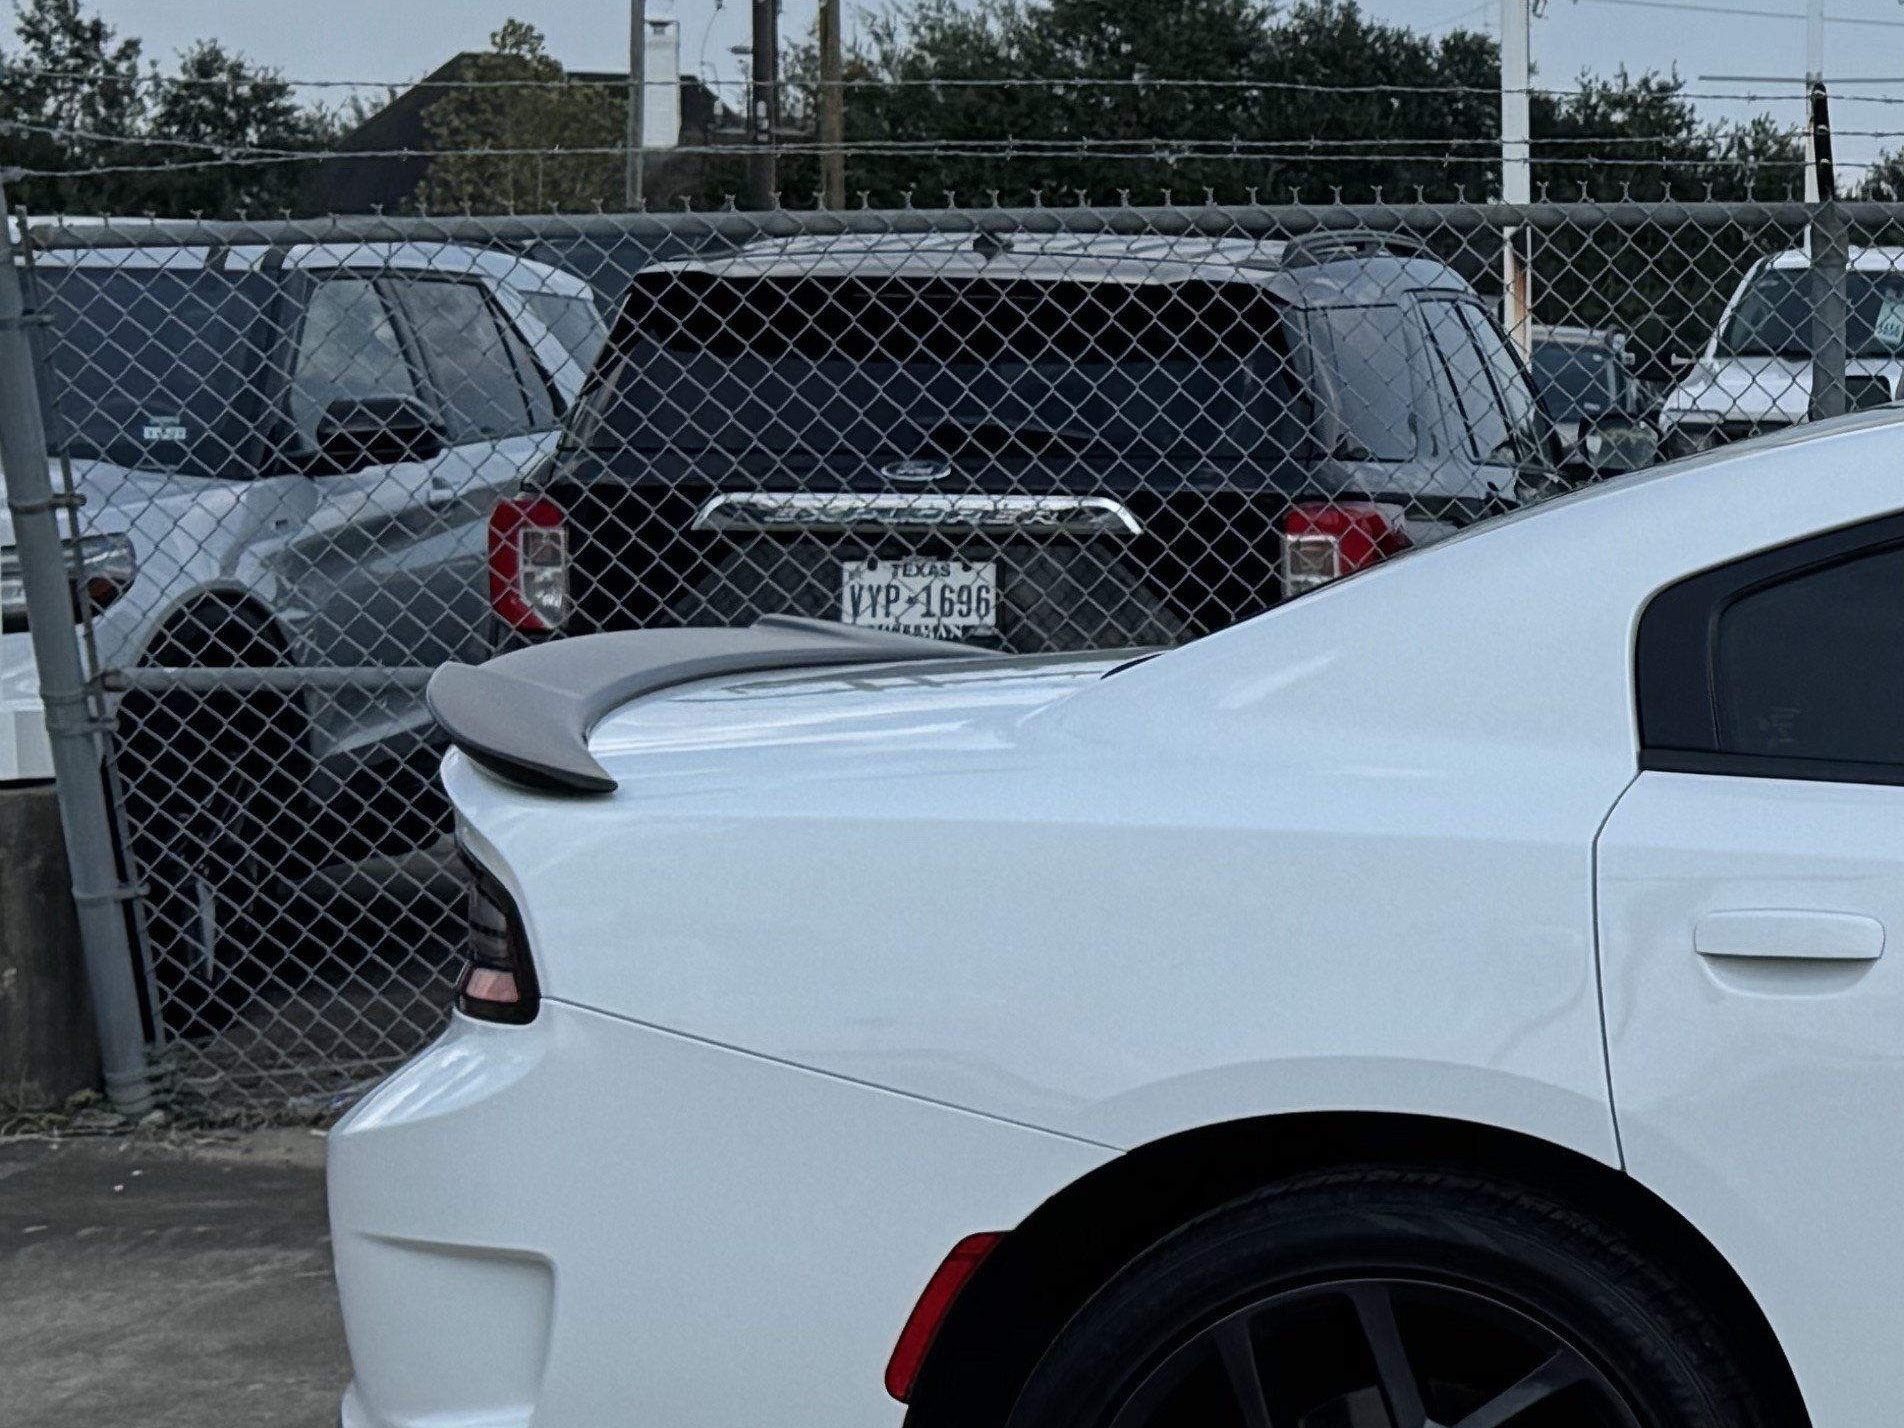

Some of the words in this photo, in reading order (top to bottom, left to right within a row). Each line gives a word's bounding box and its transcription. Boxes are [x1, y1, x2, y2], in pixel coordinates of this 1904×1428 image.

[891, 561, 951, 578] TEXAS
[850, 583, 901, 619] VYP
[920, 584, 991, 619] 1696
